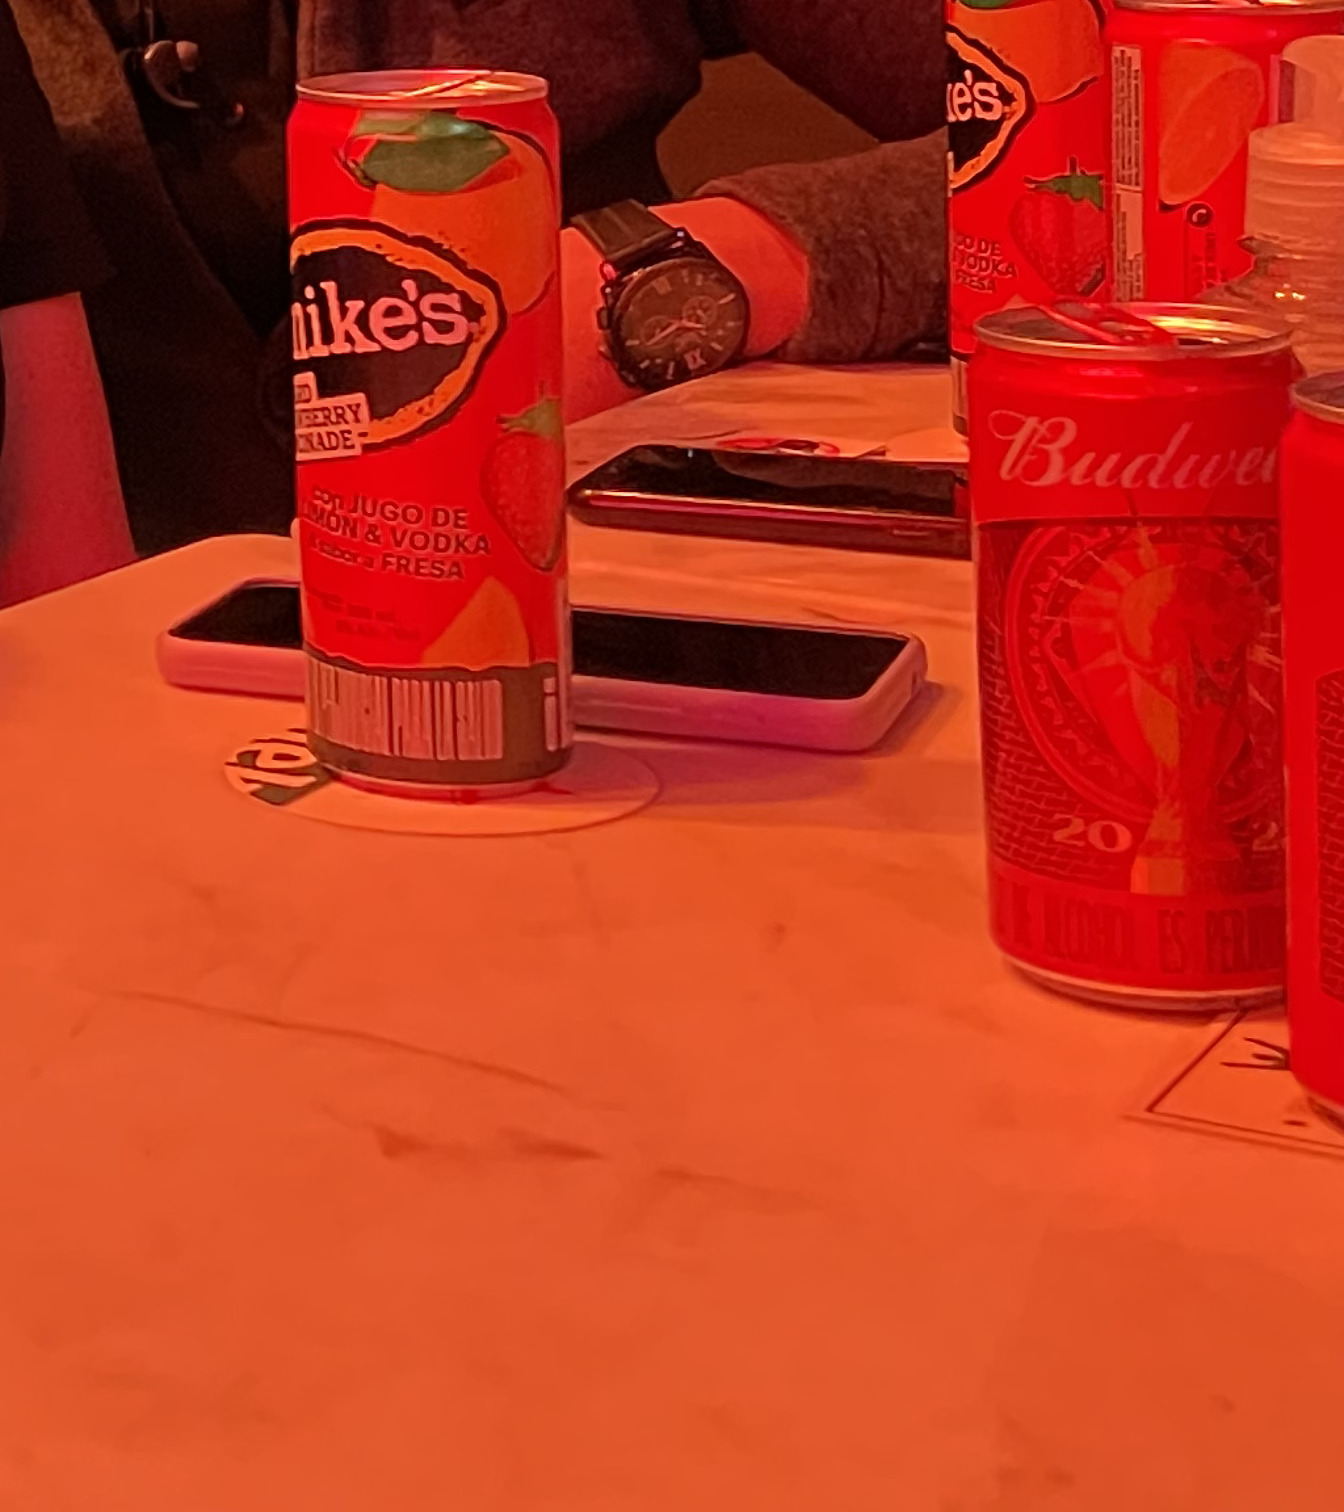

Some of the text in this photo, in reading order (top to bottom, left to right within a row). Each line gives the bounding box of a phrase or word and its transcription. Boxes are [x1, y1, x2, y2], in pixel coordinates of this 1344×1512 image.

[350, 494, 424, 525] JUGO
[430, 506, 469, 530] DE
[363, 523, 383, 545] &
[390, 526, 493, 555] VODKA
[380, 552, 464, 580] FRESA
[1052, 812, 1133, 854] 20
